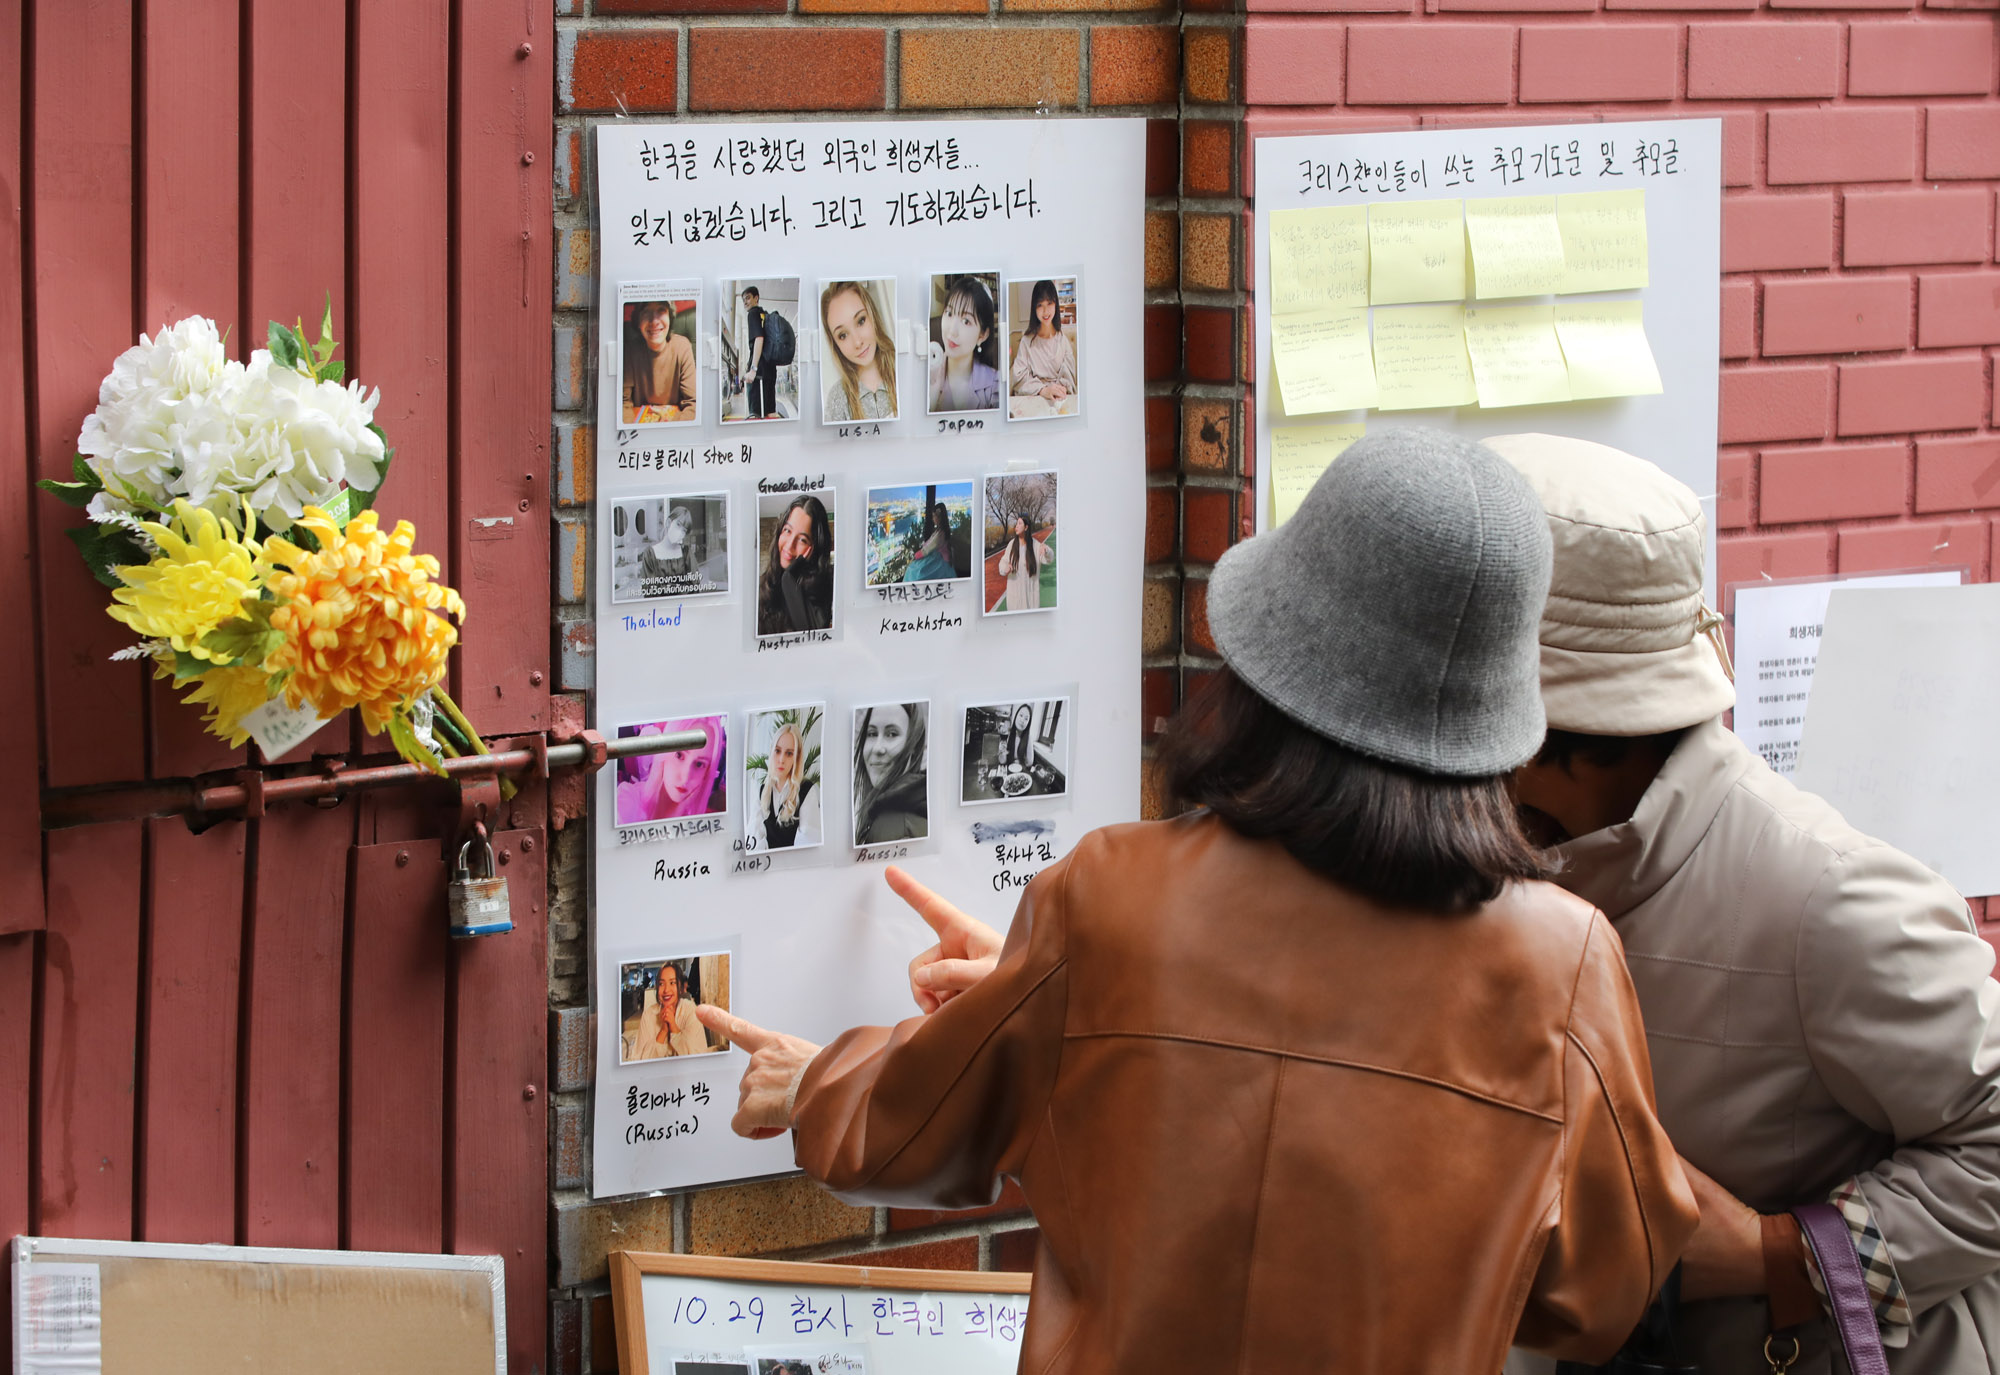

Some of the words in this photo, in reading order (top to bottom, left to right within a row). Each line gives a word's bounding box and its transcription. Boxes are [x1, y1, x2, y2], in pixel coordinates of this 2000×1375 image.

[639, 139, 698, 182] 한국을
[713, 136, 806, 177] 사랑했던
[822, 137, 877, 174] 외국인
[885, 137, 979, 174] 희생자들...
[1444, 153, 1475, 188] 쓰는
[1598, 140, 1624, 177] 및
[630, 208, 674, 247] 잊지
[683, 194, 797, 243] 않겠습니다.
[811, 195, 867, 230] 그리고
[885, 177, 1041, 228] 기도하겠습니다.
[937, 418, 984, 434] Japan
[621, 603, 683, 631] Thailand
[879, 610, 962, 635] Kazakhstan
[653, 858, 711, 882] Russia
[691, 1081, 711, 1106] 박
[625, 1115, 699, 1145] (Russia)
[790, 1292, 855, 1338] 참사
[872, 1297, 945, 1336] 한국인
